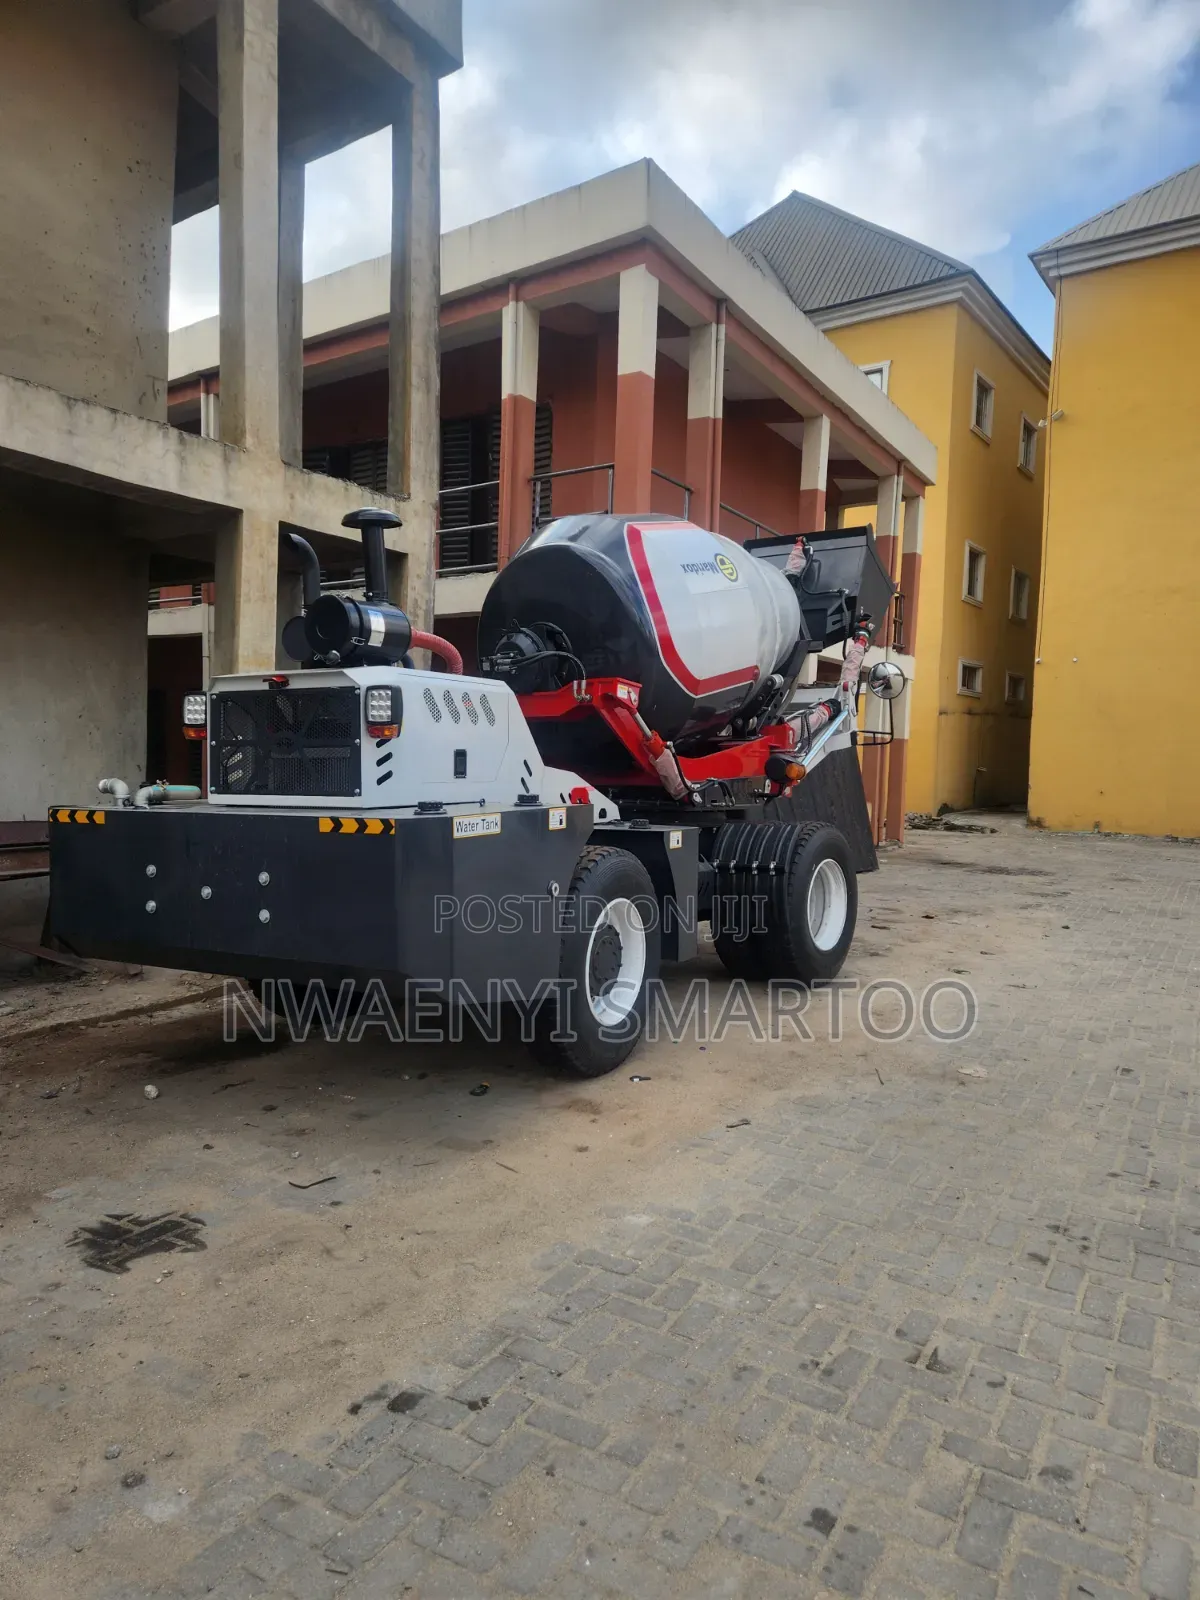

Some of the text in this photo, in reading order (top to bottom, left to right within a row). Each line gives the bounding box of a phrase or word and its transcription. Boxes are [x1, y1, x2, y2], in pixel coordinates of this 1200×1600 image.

[680, 562, 720, 576] Maridox
[455, 817, 500, 834] Water Tank
